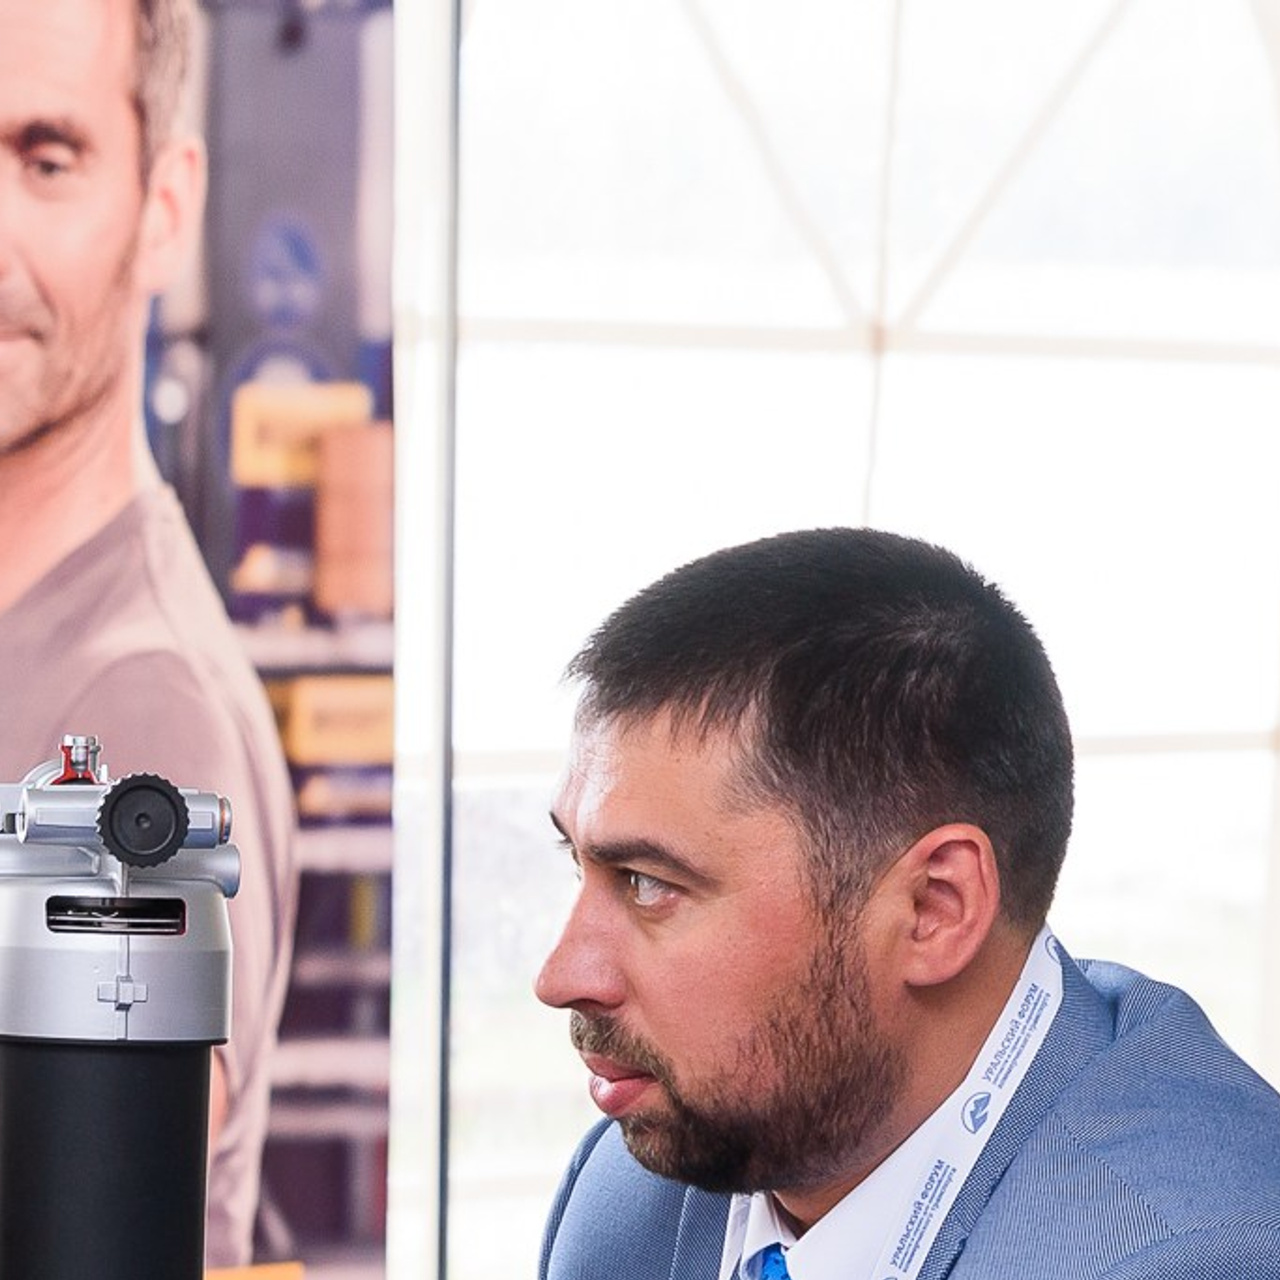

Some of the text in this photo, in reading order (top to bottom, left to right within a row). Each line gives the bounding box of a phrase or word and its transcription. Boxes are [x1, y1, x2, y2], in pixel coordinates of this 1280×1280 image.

[982, 1019, 1021, 1083] УРАЛЬСКИЙ
[1017, 983, 1038, 1019] ФОРУМ
[890, 1200, 924, 1267] УРАЛЬСКИЙ
[921, 1159, 945, 1200] ФОРУМ
